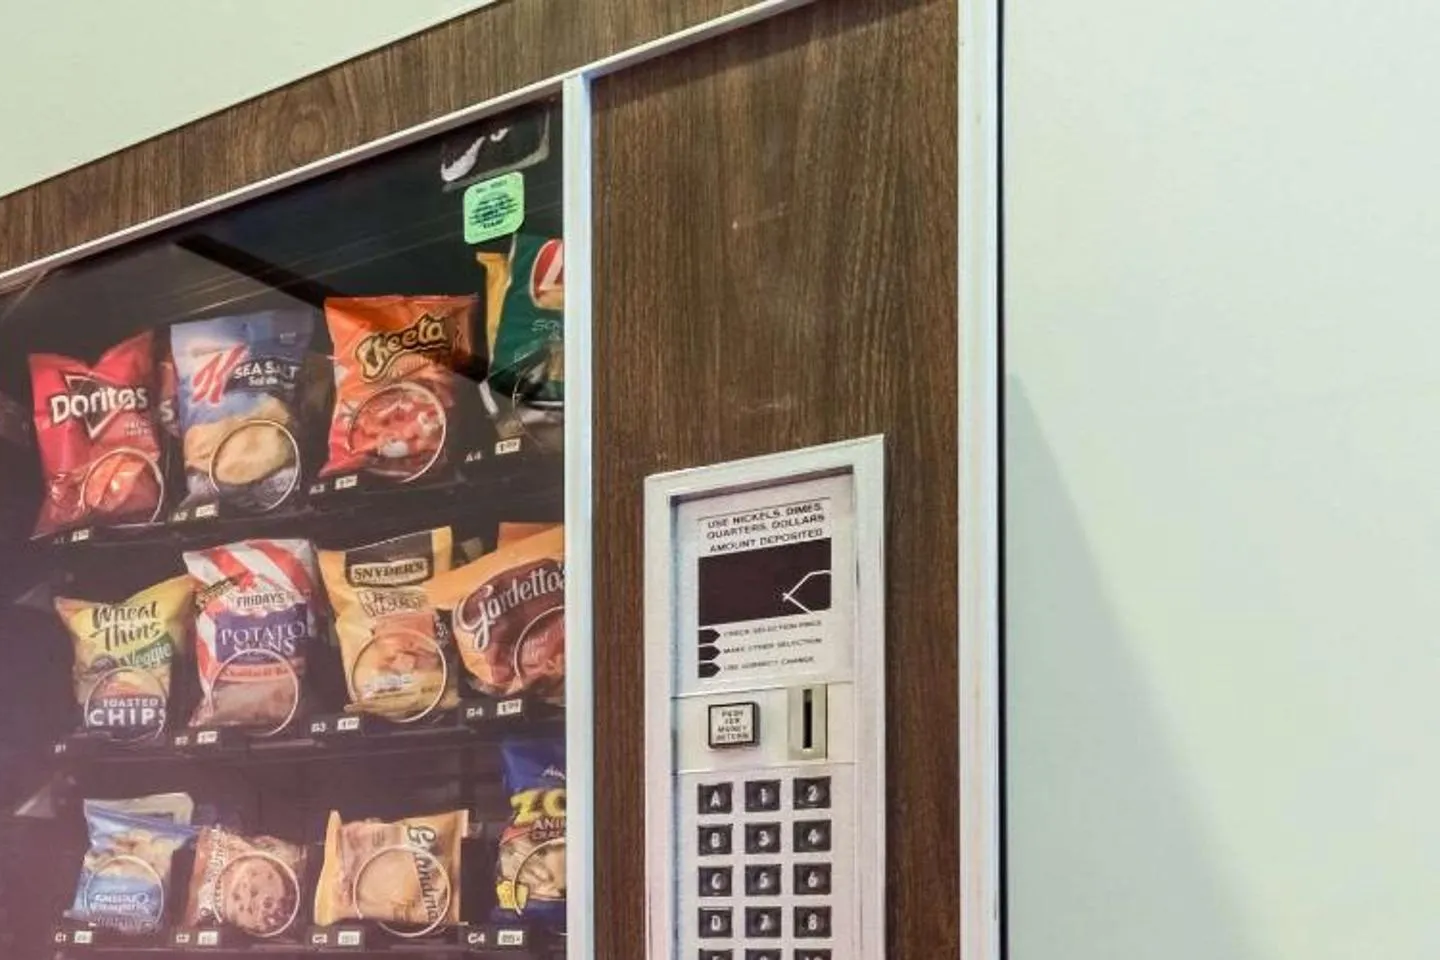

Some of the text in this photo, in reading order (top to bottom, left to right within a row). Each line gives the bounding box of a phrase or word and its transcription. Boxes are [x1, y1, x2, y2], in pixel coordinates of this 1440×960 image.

[50, 387, 148, 424] Doritos
[708, 517, 728, 529] USE
[772, 514, 825, 530] DOLLARS
[710, 527, 823, 554] AMOUNT DEPOSITED
[222, 620, 306, 646] POTATO
[710, 790, 720, 806] A
[760, 788, 768, 803] 1
[807, 784, 819, 802] 2
[711, 833, 721, 849] B
[759, 830, 770, 847] 3
[807, 828, 819, 845] 4
[712, 873, 722, 890] C
[759, 871, 769, 889] 5
[808, 870, 818, 888] 6
[711, 915, 722, 931] D
[759, 914, 770, 931] 7
[808, 913, 818, 931] 8
[55, 932, 67, 943] C1
[468, 932, 486, 944] C4
